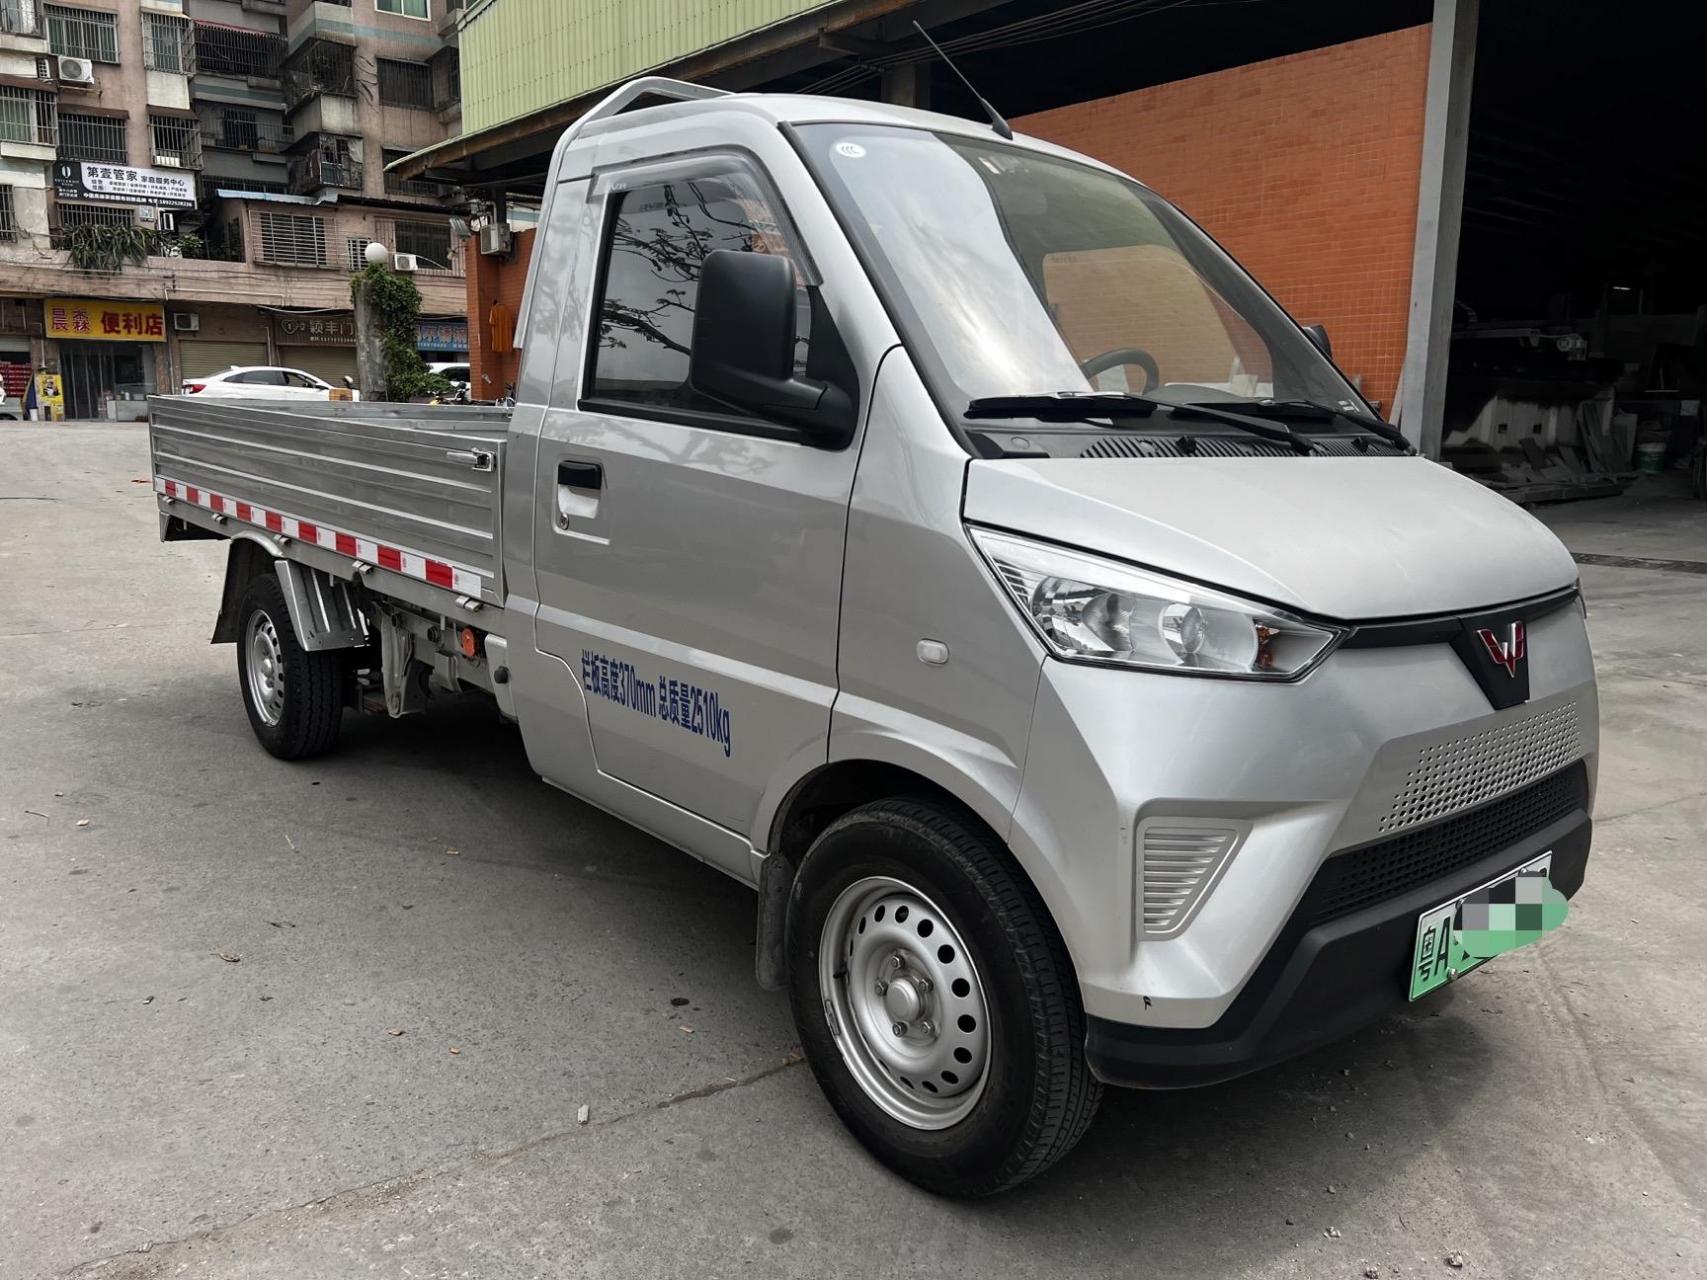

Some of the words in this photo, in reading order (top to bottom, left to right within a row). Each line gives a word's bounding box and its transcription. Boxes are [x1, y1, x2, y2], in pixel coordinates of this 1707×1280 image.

[87, 166, 138, 181] 第壹管家
[141, 175, 185, 187] 家庭服务中心
[101, 310, 163, 336] 便利店
[582, 649, 656, 717] 栏板高度370mm
[659, 675, 731, 758] 总质量2510kg
